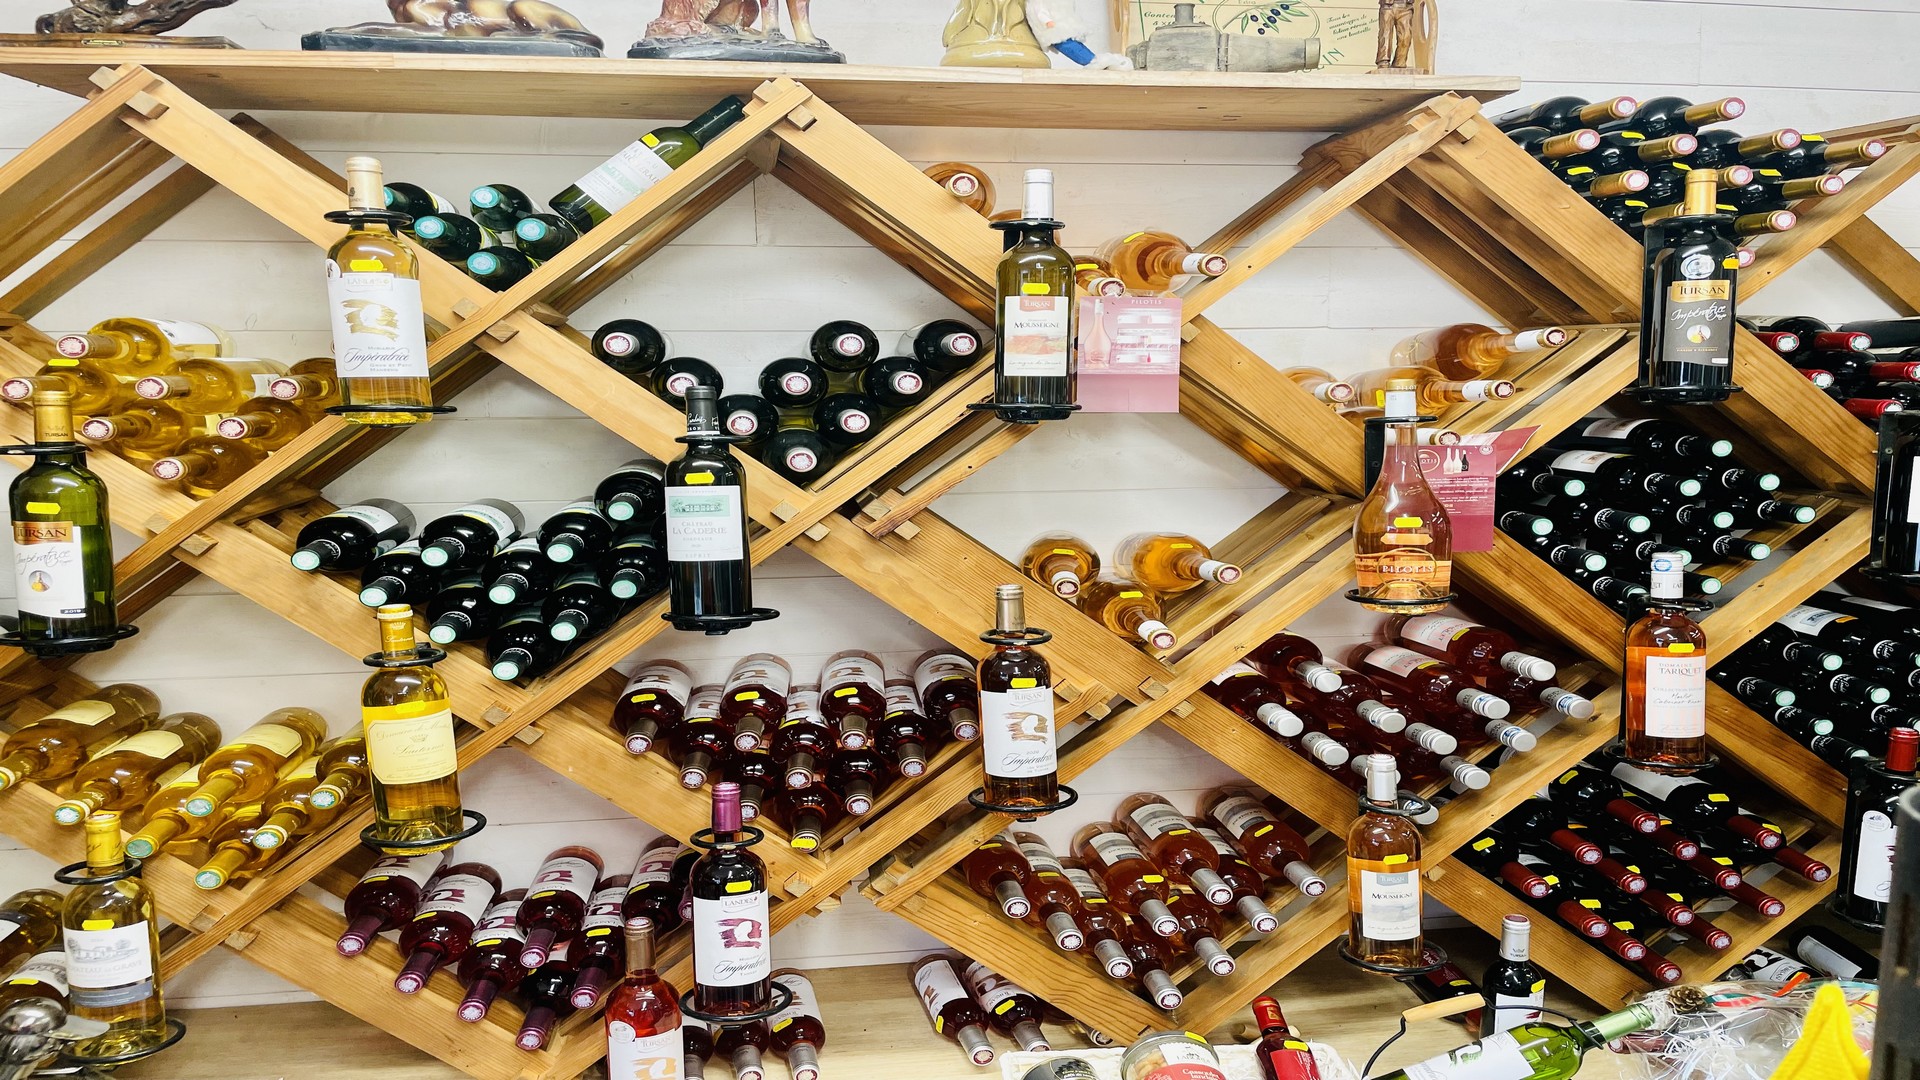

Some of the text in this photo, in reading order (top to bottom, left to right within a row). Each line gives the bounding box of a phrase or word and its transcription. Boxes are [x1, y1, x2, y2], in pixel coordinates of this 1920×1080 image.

[1678, 285, 1727, 297] TURSAN
[1024, 299, 1050, 308] TURSAN
[17, 526, 68, 540] TURSAN
[683, 526, 727, 535] CADERIE
[1382, 565, 1434, 573] PILOTIS
[1659, 666, 1703, 677] TARIQUET
[725, 898, 753, 906] LANDES
